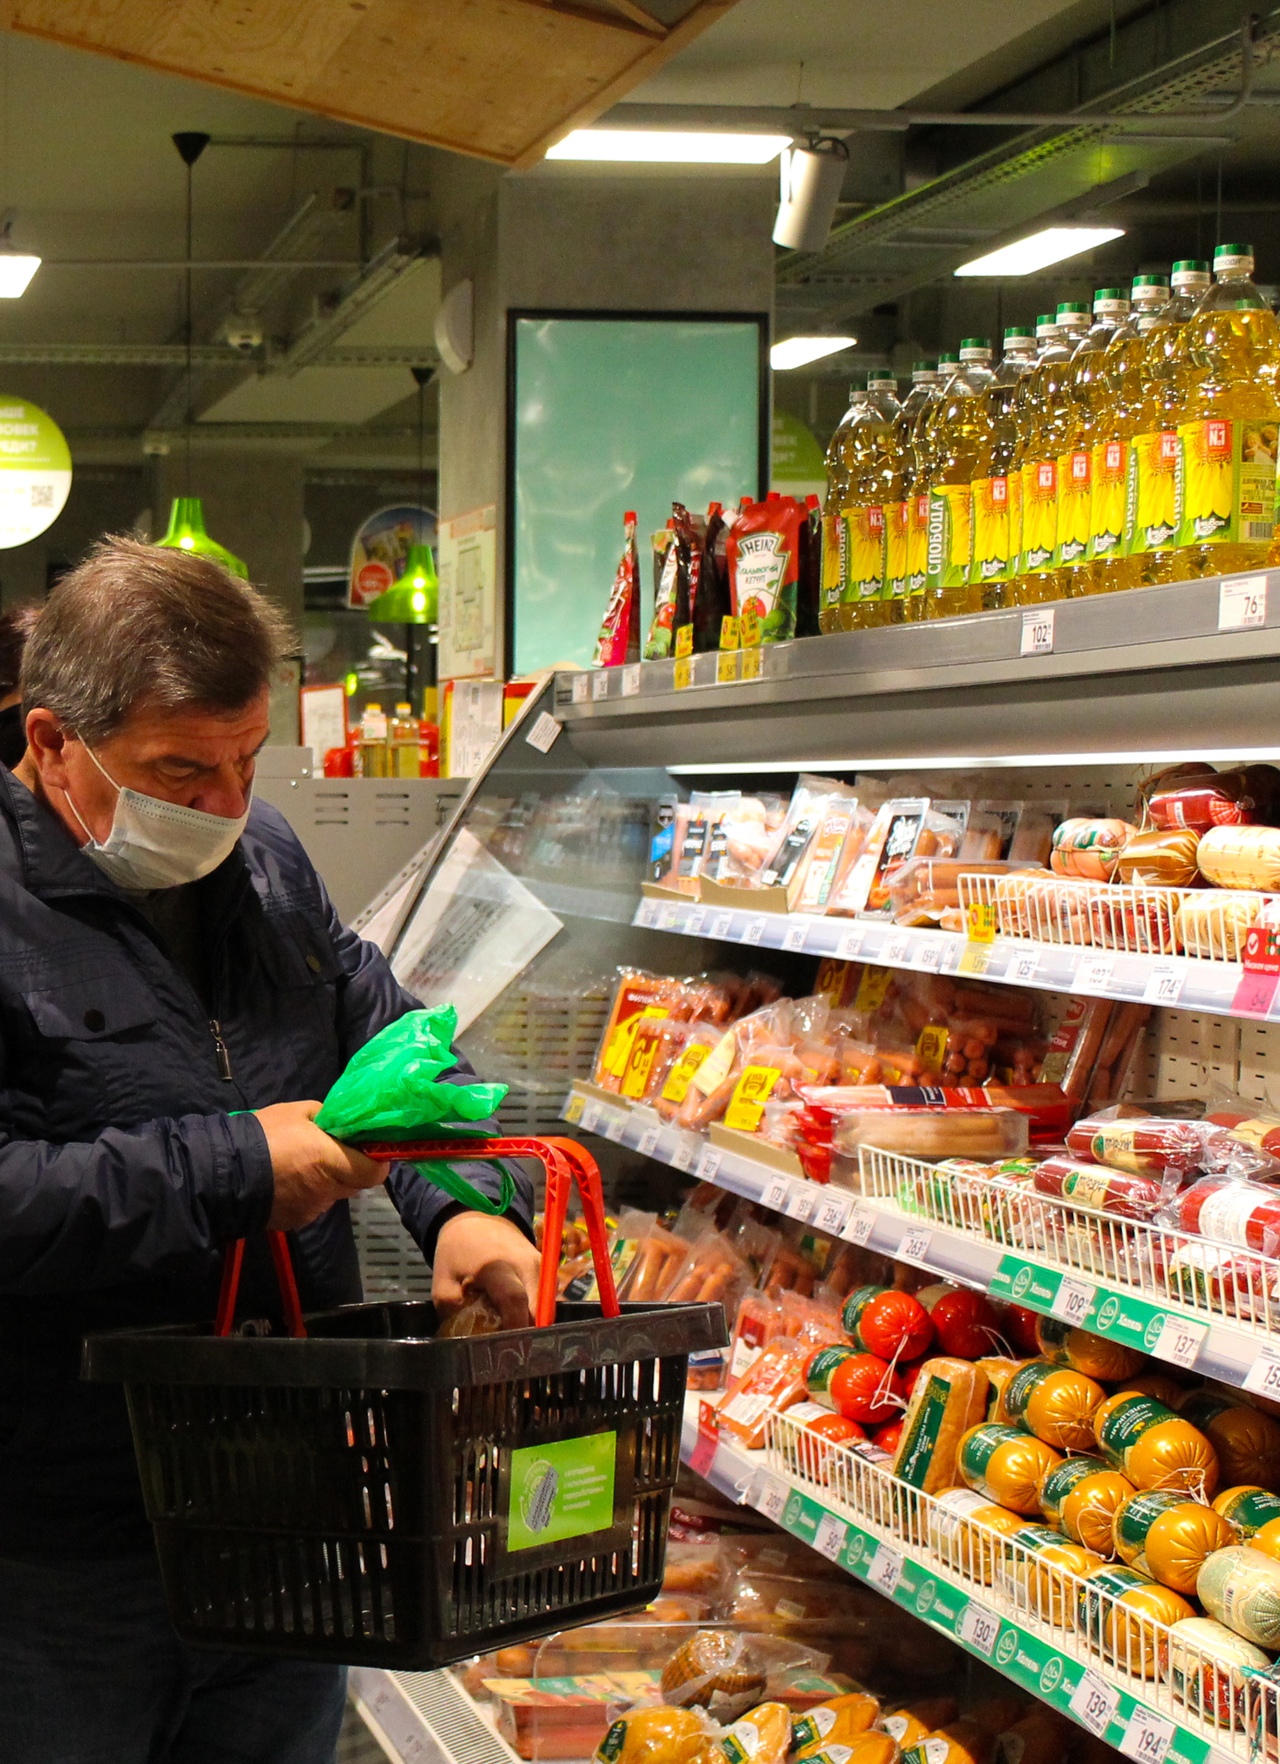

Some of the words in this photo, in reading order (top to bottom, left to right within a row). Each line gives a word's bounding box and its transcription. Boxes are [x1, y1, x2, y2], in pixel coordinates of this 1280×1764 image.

[745, 539, 774, 555] HEINZ
[927, 500, 944, 575] СЛОБОДА
[1244, 595, 1258, 616] 76
[1032, 625, 1048, 643] 102
[1158, 978, 1176, 996] 174
[823, 1207, 838, 1224] 236
[905, 1239, 922, 1256] 263
[1065, 1292, 1085, 1314] 109
[1173, 1333, 1195, 1355] 137
[826, 1531, 838, 1549] 50
[882, 1561, 896, 1582] 34
[972, 1617, 991, 1643] 130
[1085, 1690, 1107, 1718] 139
[1137, 1728, 1161, 1757] 194
